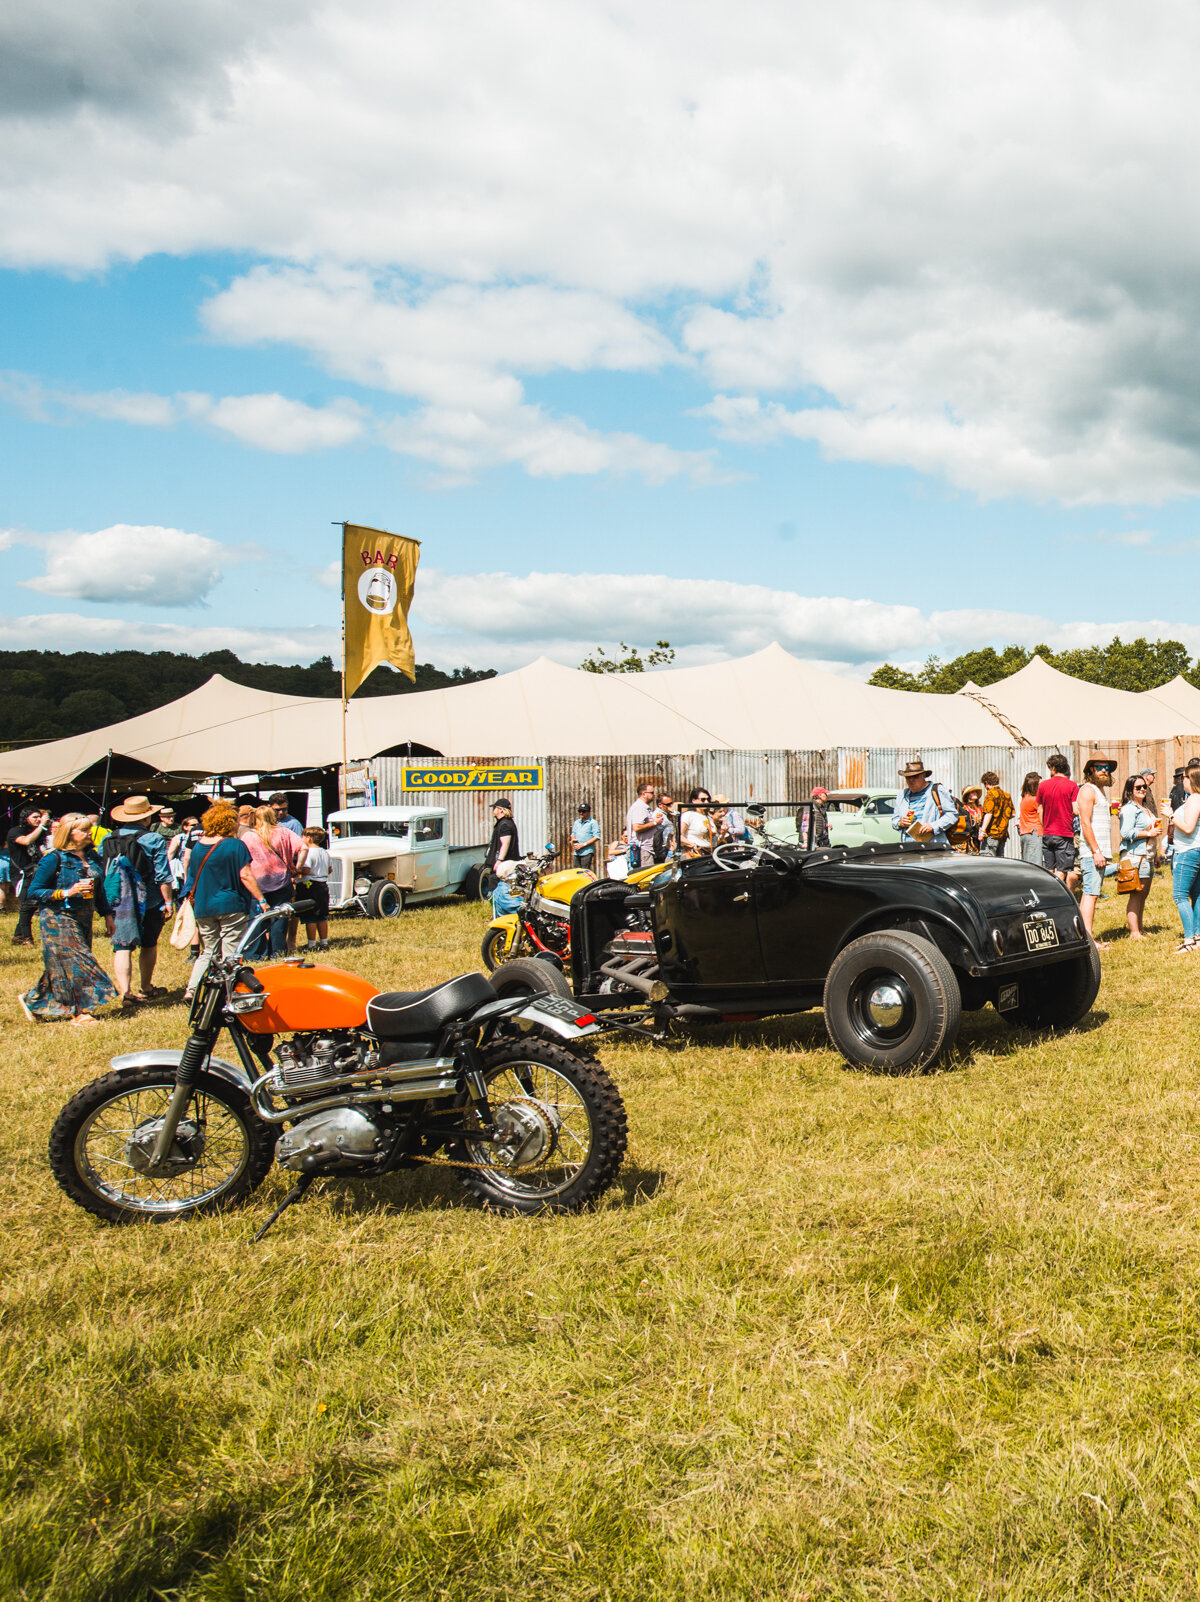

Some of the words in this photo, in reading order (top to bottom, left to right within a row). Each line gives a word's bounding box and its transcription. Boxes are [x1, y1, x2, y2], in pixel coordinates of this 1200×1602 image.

[360, 550, 399, 571] BAR
[410, 770, 533, 786] GOODYEAR
[1040, 925, 1055, 941] 845
